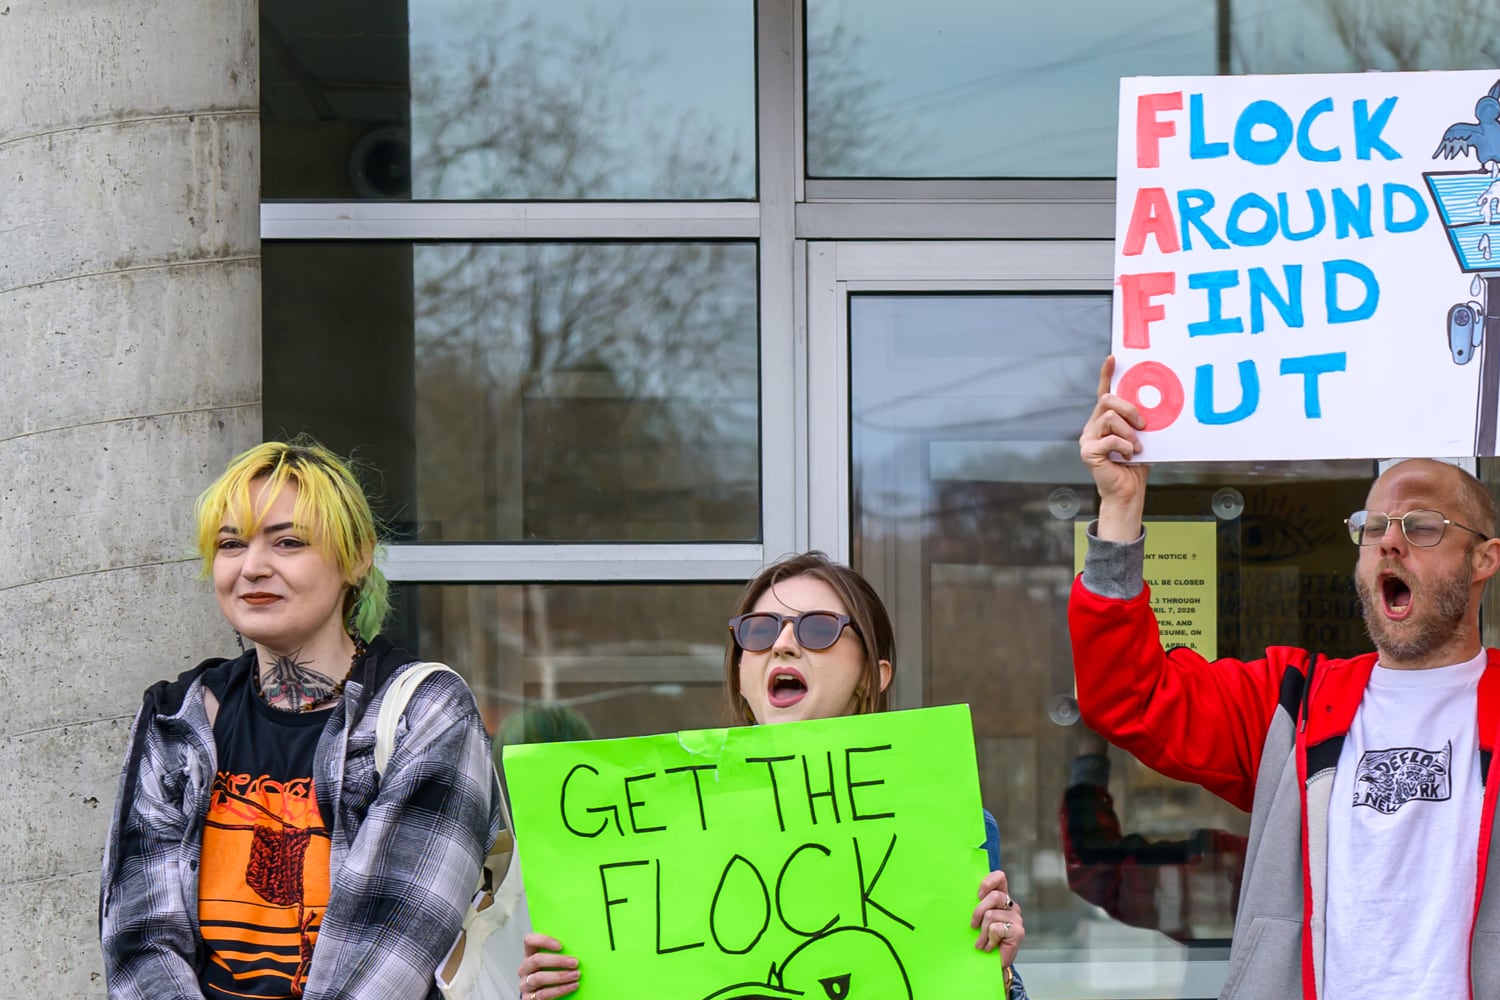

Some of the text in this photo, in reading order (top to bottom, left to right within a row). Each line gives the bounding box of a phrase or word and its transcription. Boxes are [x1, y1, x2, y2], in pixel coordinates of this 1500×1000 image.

[1136, 91, 1403, 168] FLOCK
[1122, 183, 1430, 256] AROUND
[1116, 258, 1381, 349] FIND
[1116, 352, 1347, 432] OUT
[560, 744, 895, 838] GET THE
[599, 833, 915, 955] FLOCK
